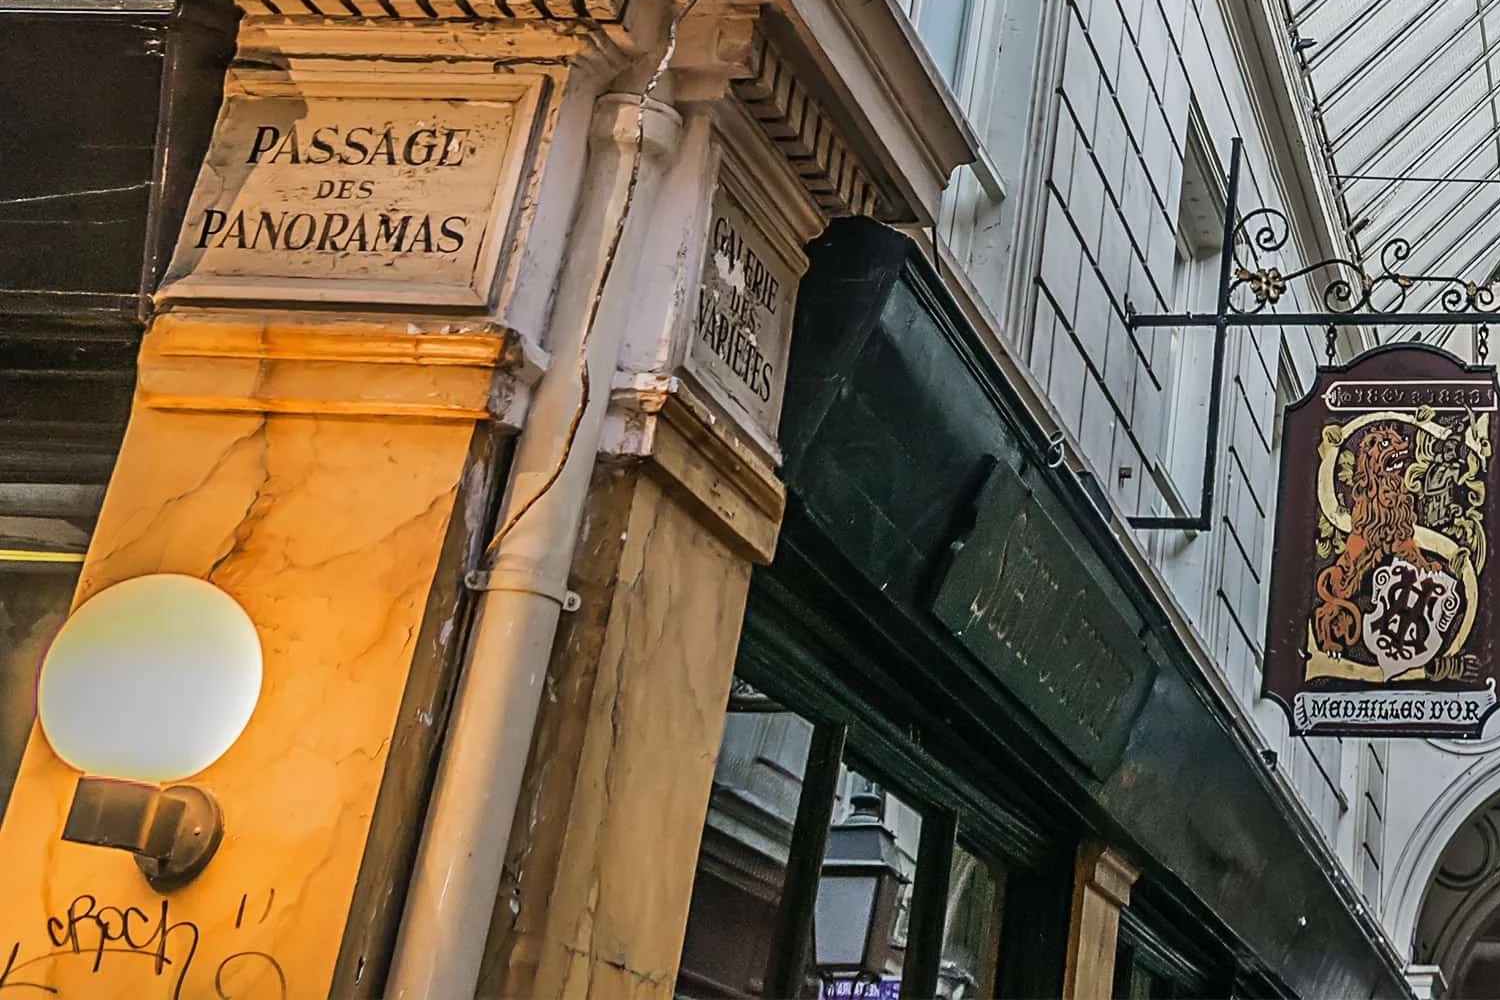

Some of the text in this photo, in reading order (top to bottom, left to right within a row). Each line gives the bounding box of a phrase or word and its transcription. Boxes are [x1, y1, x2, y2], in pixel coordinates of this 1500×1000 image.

[246, 125, 470, 166] PASSAGE
[313, 180, 375, 200] DES
[195, 209, 469, 253] PANORAMAS
[1430, 700, 1480, 721] D'OR
